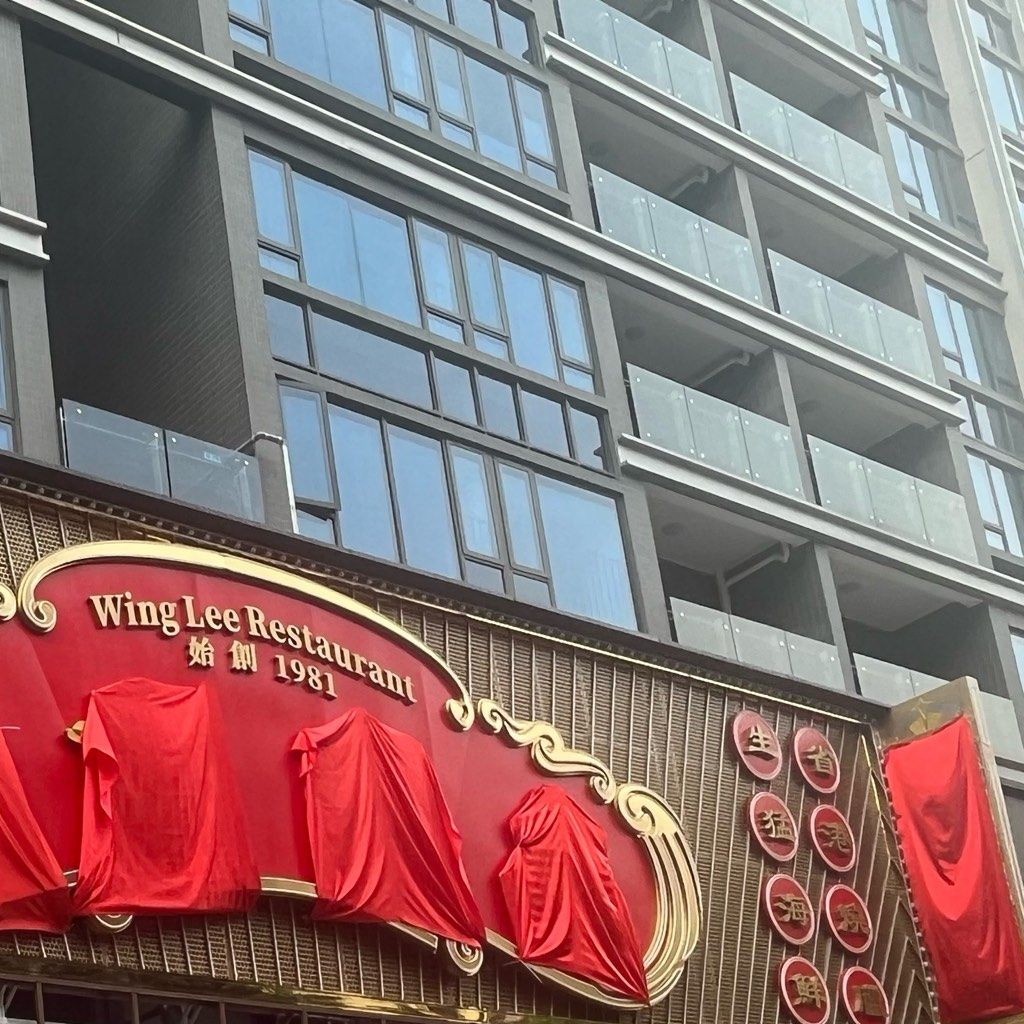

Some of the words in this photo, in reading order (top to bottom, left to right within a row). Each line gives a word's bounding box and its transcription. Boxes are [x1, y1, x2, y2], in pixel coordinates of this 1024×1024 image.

[89, 592, 181, 637] Wing
[181, 595, 242, 633] Lee
[244, 605, 418, 704] Restaurant
[275, 654, 339, 699] 1981
